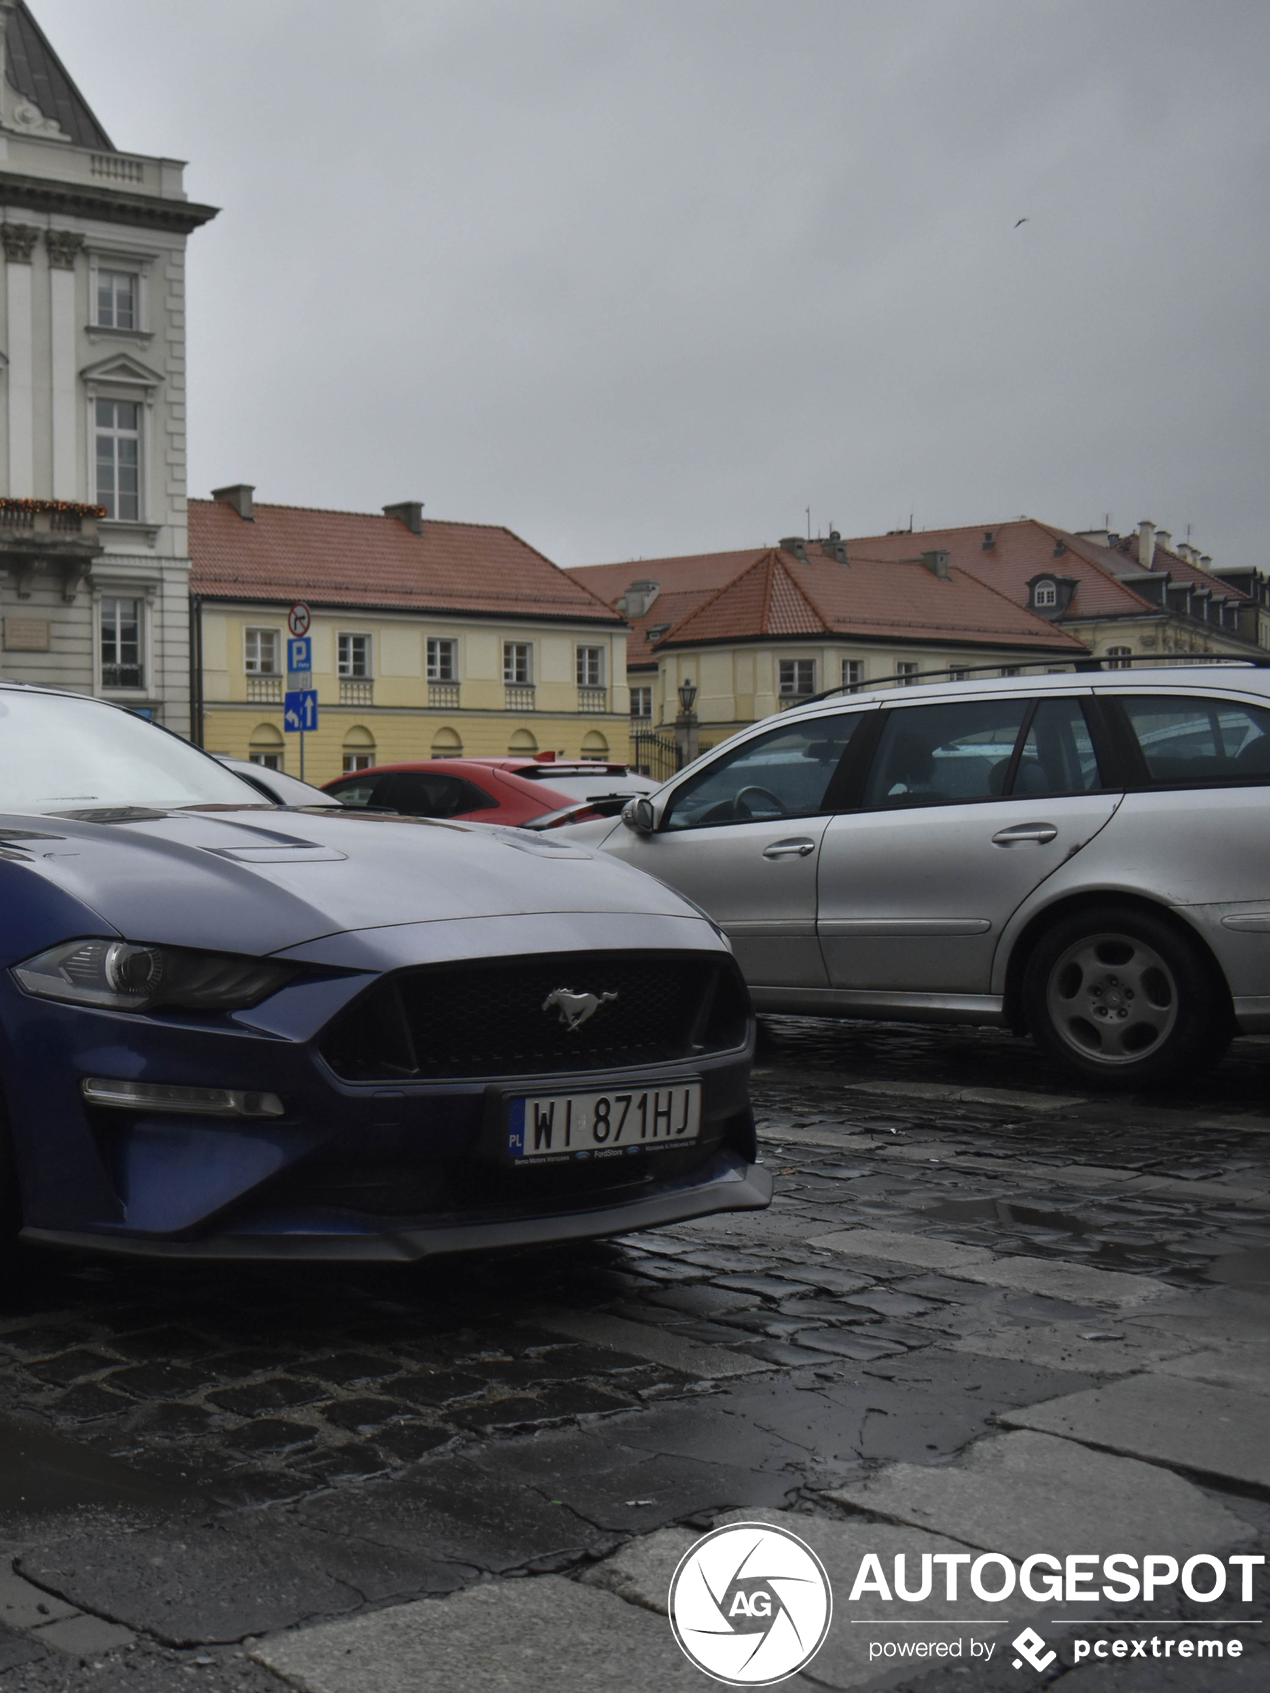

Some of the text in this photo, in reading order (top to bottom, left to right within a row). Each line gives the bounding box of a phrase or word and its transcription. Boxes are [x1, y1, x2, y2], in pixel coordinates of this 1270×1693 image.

[293, 641, 306, 668] P
[534, 1088, 690, 1150] WI 871HJ
[509, 1134, 522, 1148] PL
[594, 1148, 623, 1159] FordStore
